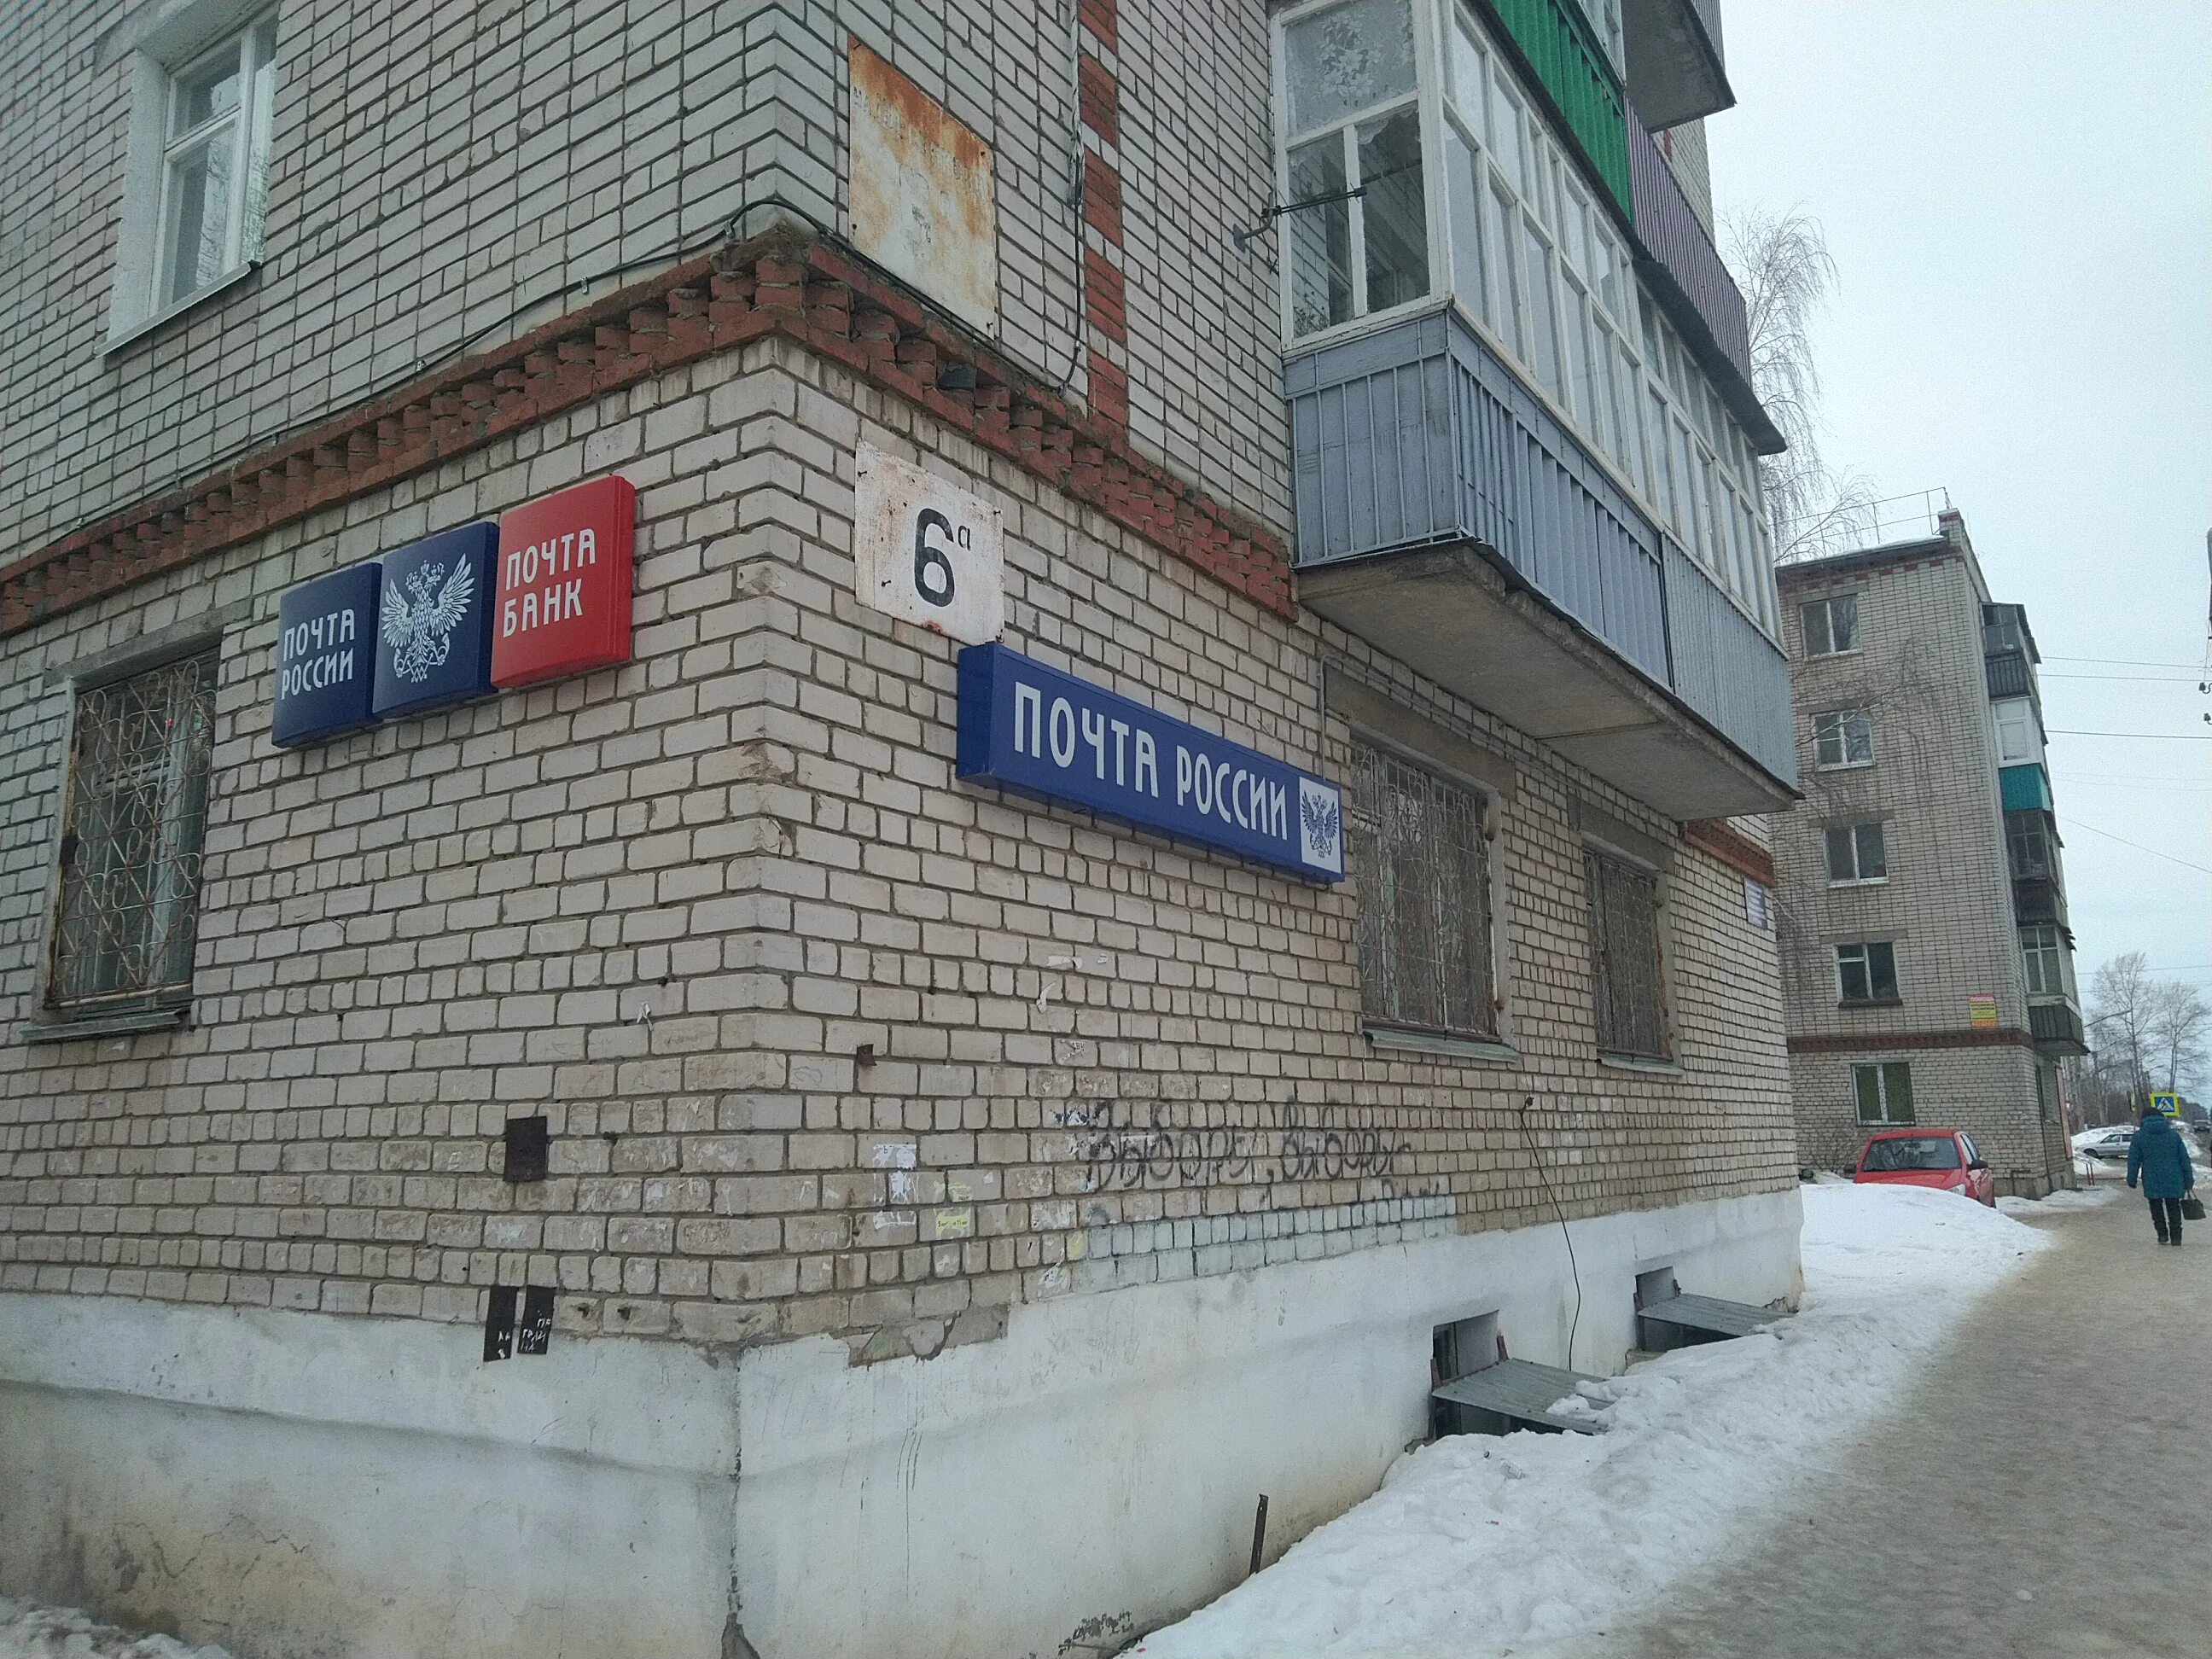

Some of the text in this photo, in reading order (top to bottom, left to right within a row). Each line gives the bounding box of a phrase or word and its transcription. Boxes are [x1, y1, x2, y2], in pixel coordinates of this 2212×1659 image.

[504, 527, 597, 592] ПОЧТА
[913, 508, 971, 608] 6а
[283, 608, 355, 662] ПОЧТА
[502, 578, 584, 638] БАНК
[281, 647, 353, 701] РОССИИ
[1013, 681, 1289, 841] ПОЧТА РОССИИ
